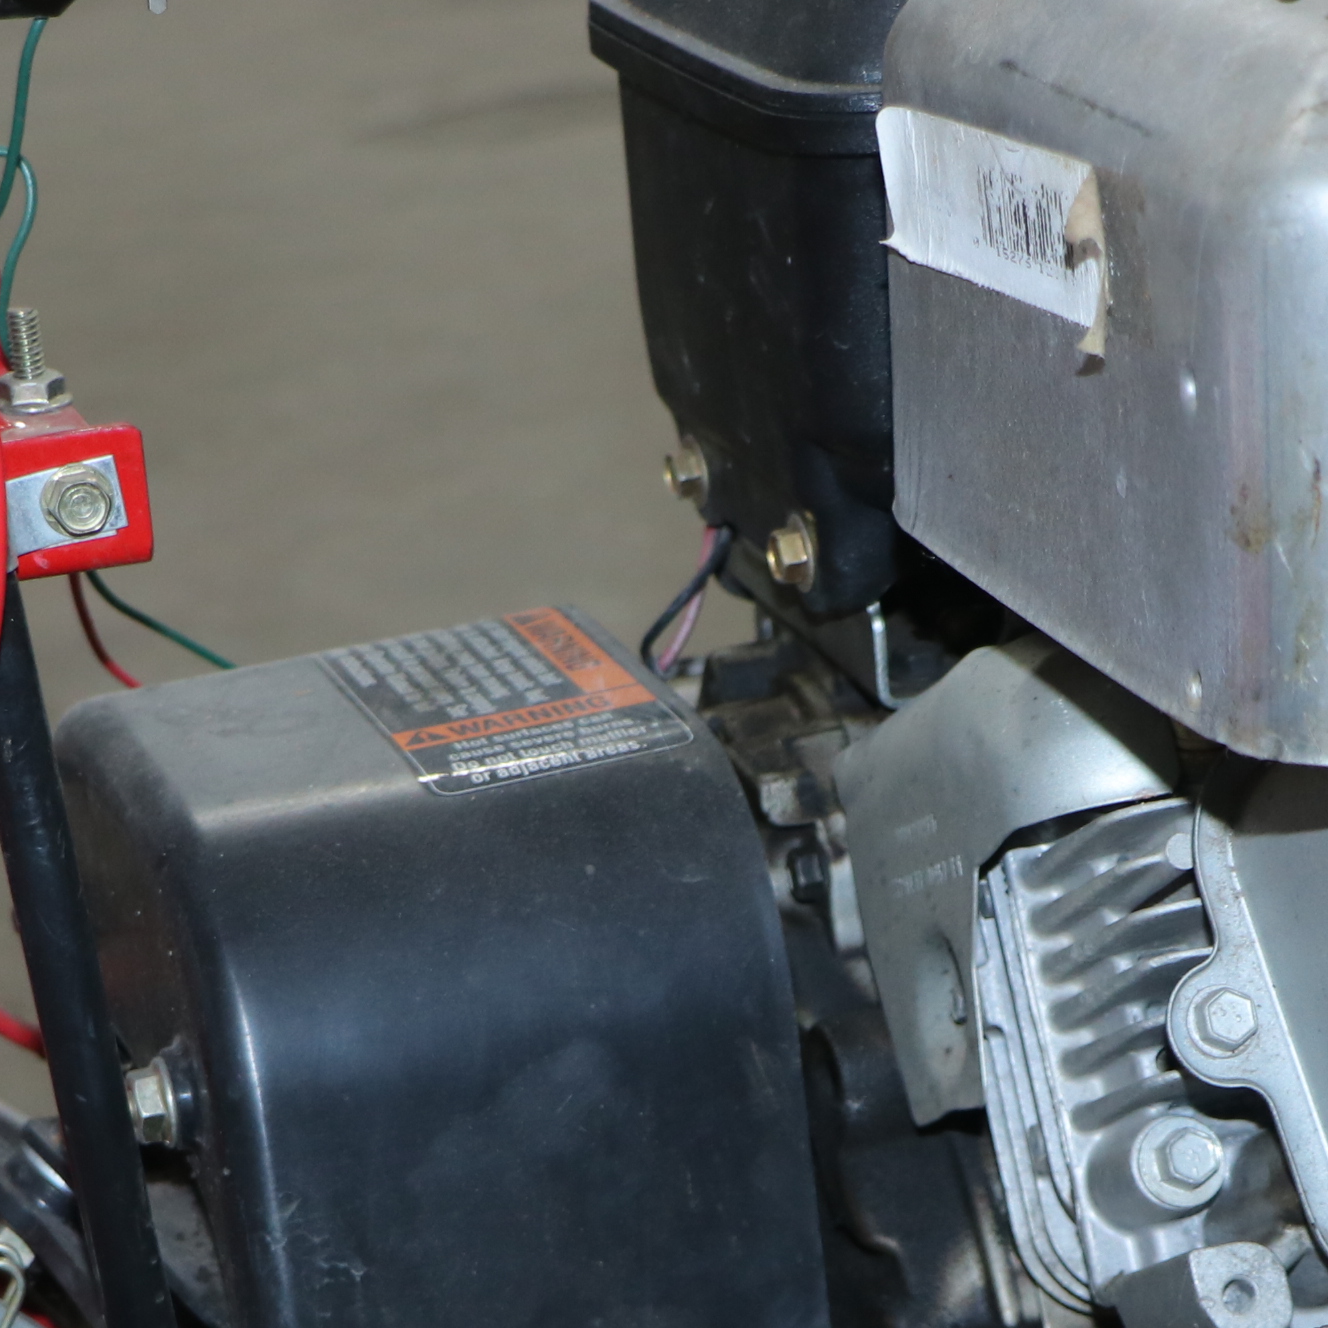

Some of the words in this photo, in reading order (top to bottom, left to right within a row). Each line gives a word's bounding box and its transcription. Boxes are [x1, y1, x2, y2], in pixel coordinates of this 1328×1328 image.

[448, 695, 612, 737] WARNING
[452, 736, 488, 750] Hot
[492, 721, 574, 743] surfaces
[577, 712, 613, 726] can
[448, 743, 505, 761] cause
[510, 730, 575, 750] severe
[451, 759, 480, 773] Do
[484, 751, 516, 767] not
[519, 739, 574, 758] touch
[578, 725, 647, 745] muffler
[472, 770, 491, 784] or
[497, 752, 581, 776] adjacent
